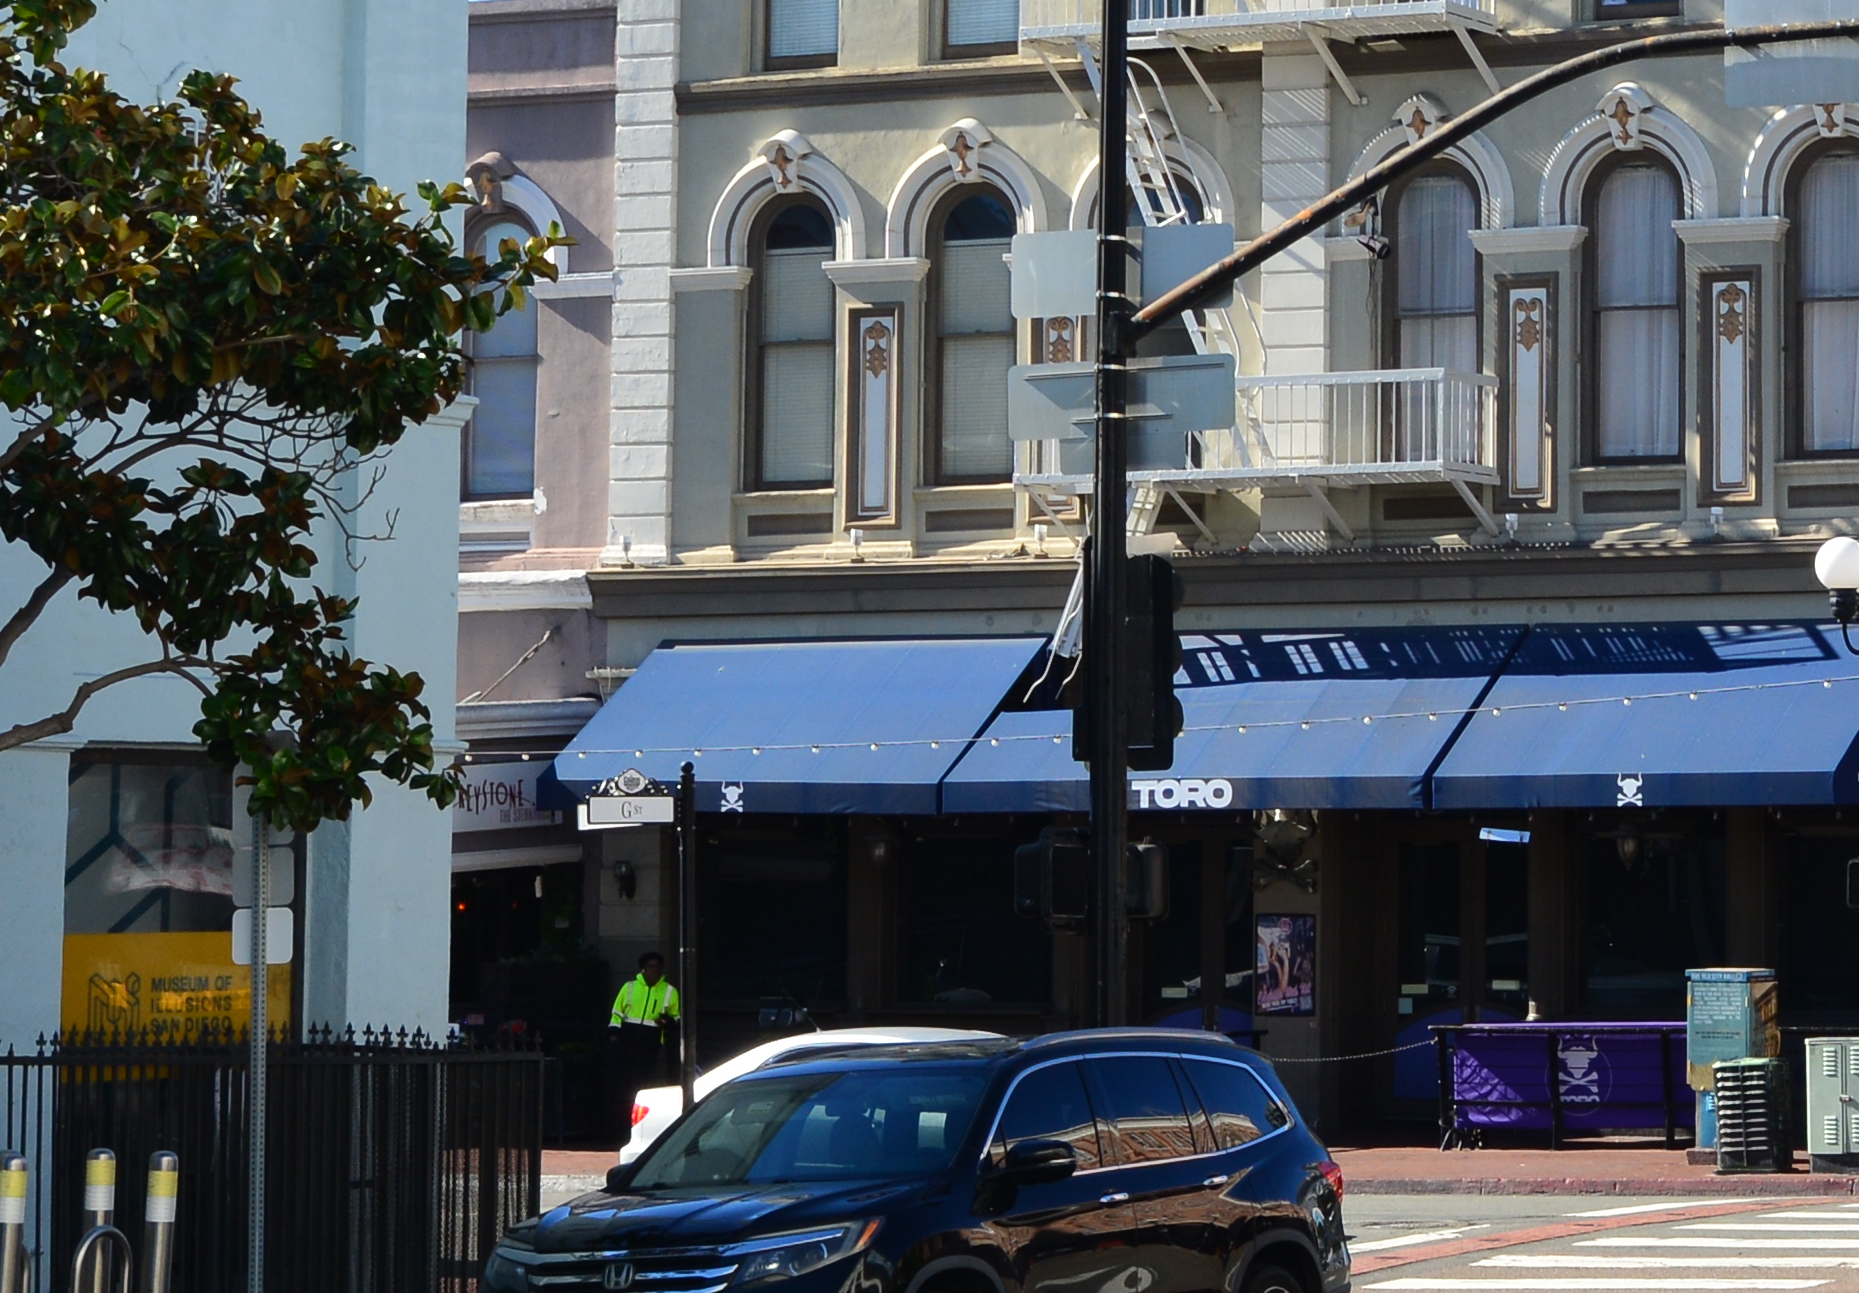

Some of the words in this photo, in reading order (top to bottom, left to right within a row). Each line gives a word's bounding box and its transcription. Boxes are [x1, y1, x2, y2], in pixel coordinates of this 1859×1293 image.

[1131, 779, 1233, 809] TORO
[621, 800, 632, 819] G
[151, 976, 209, 992] MUSEUM
[214, 976, 233, 991] OF
[151, 996, 232, 1013] ILLUSIONS
[151, 1017, 180, 1033] SAN
